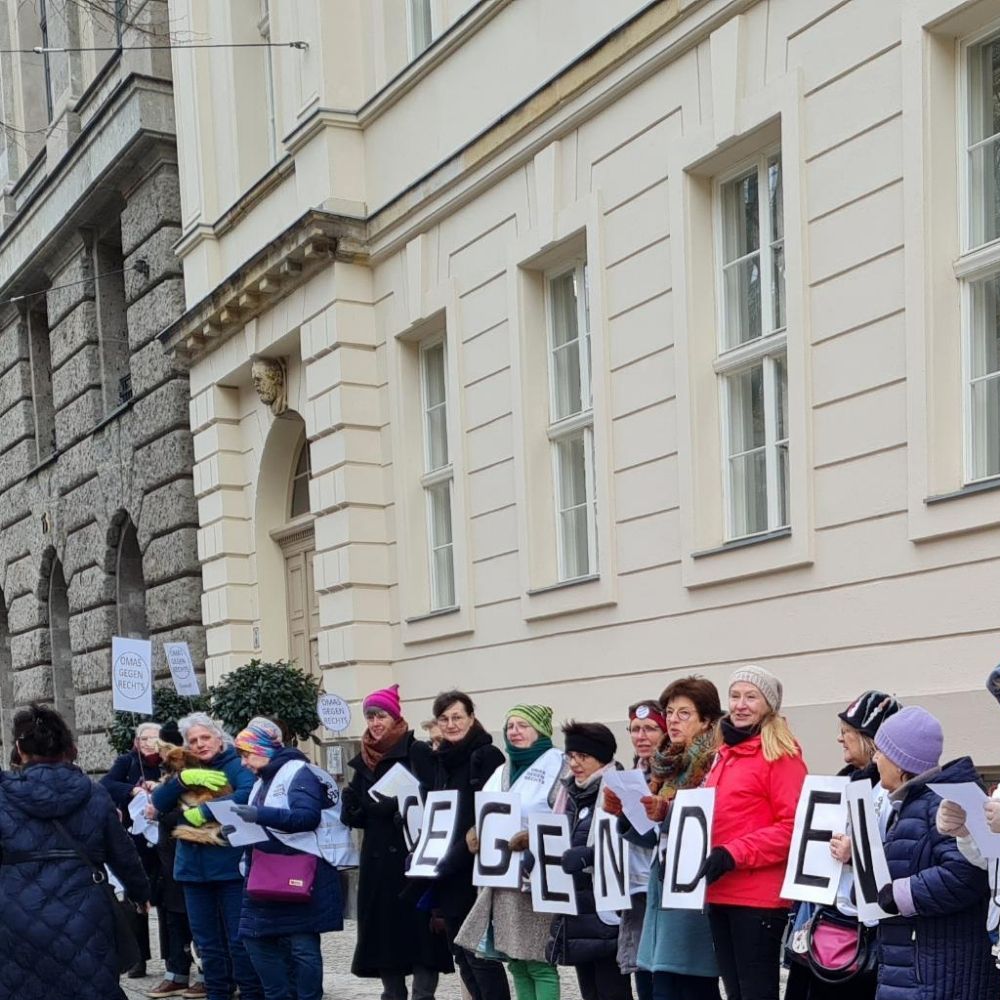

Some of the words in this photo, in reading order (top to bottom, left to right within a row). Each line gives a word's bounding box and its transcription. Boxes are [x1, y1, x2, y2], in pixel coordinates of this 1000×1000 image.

[118, 668, 144, 680] GEGEN
[118, 680, 145, 692] RECHTS
[119, 656, 142, 668] OMAS
[320, 698, 342, 706] OMAS
[321, 706, 345, 715] GEGEN
[415, 801, 452, 866] E
[478, 801, 512, 876] G
[537, 824, 570, 903] E
[599, 818, 626, 898] N
[671, 805, 708, 894] D
[793, 790, 841, 889] E
